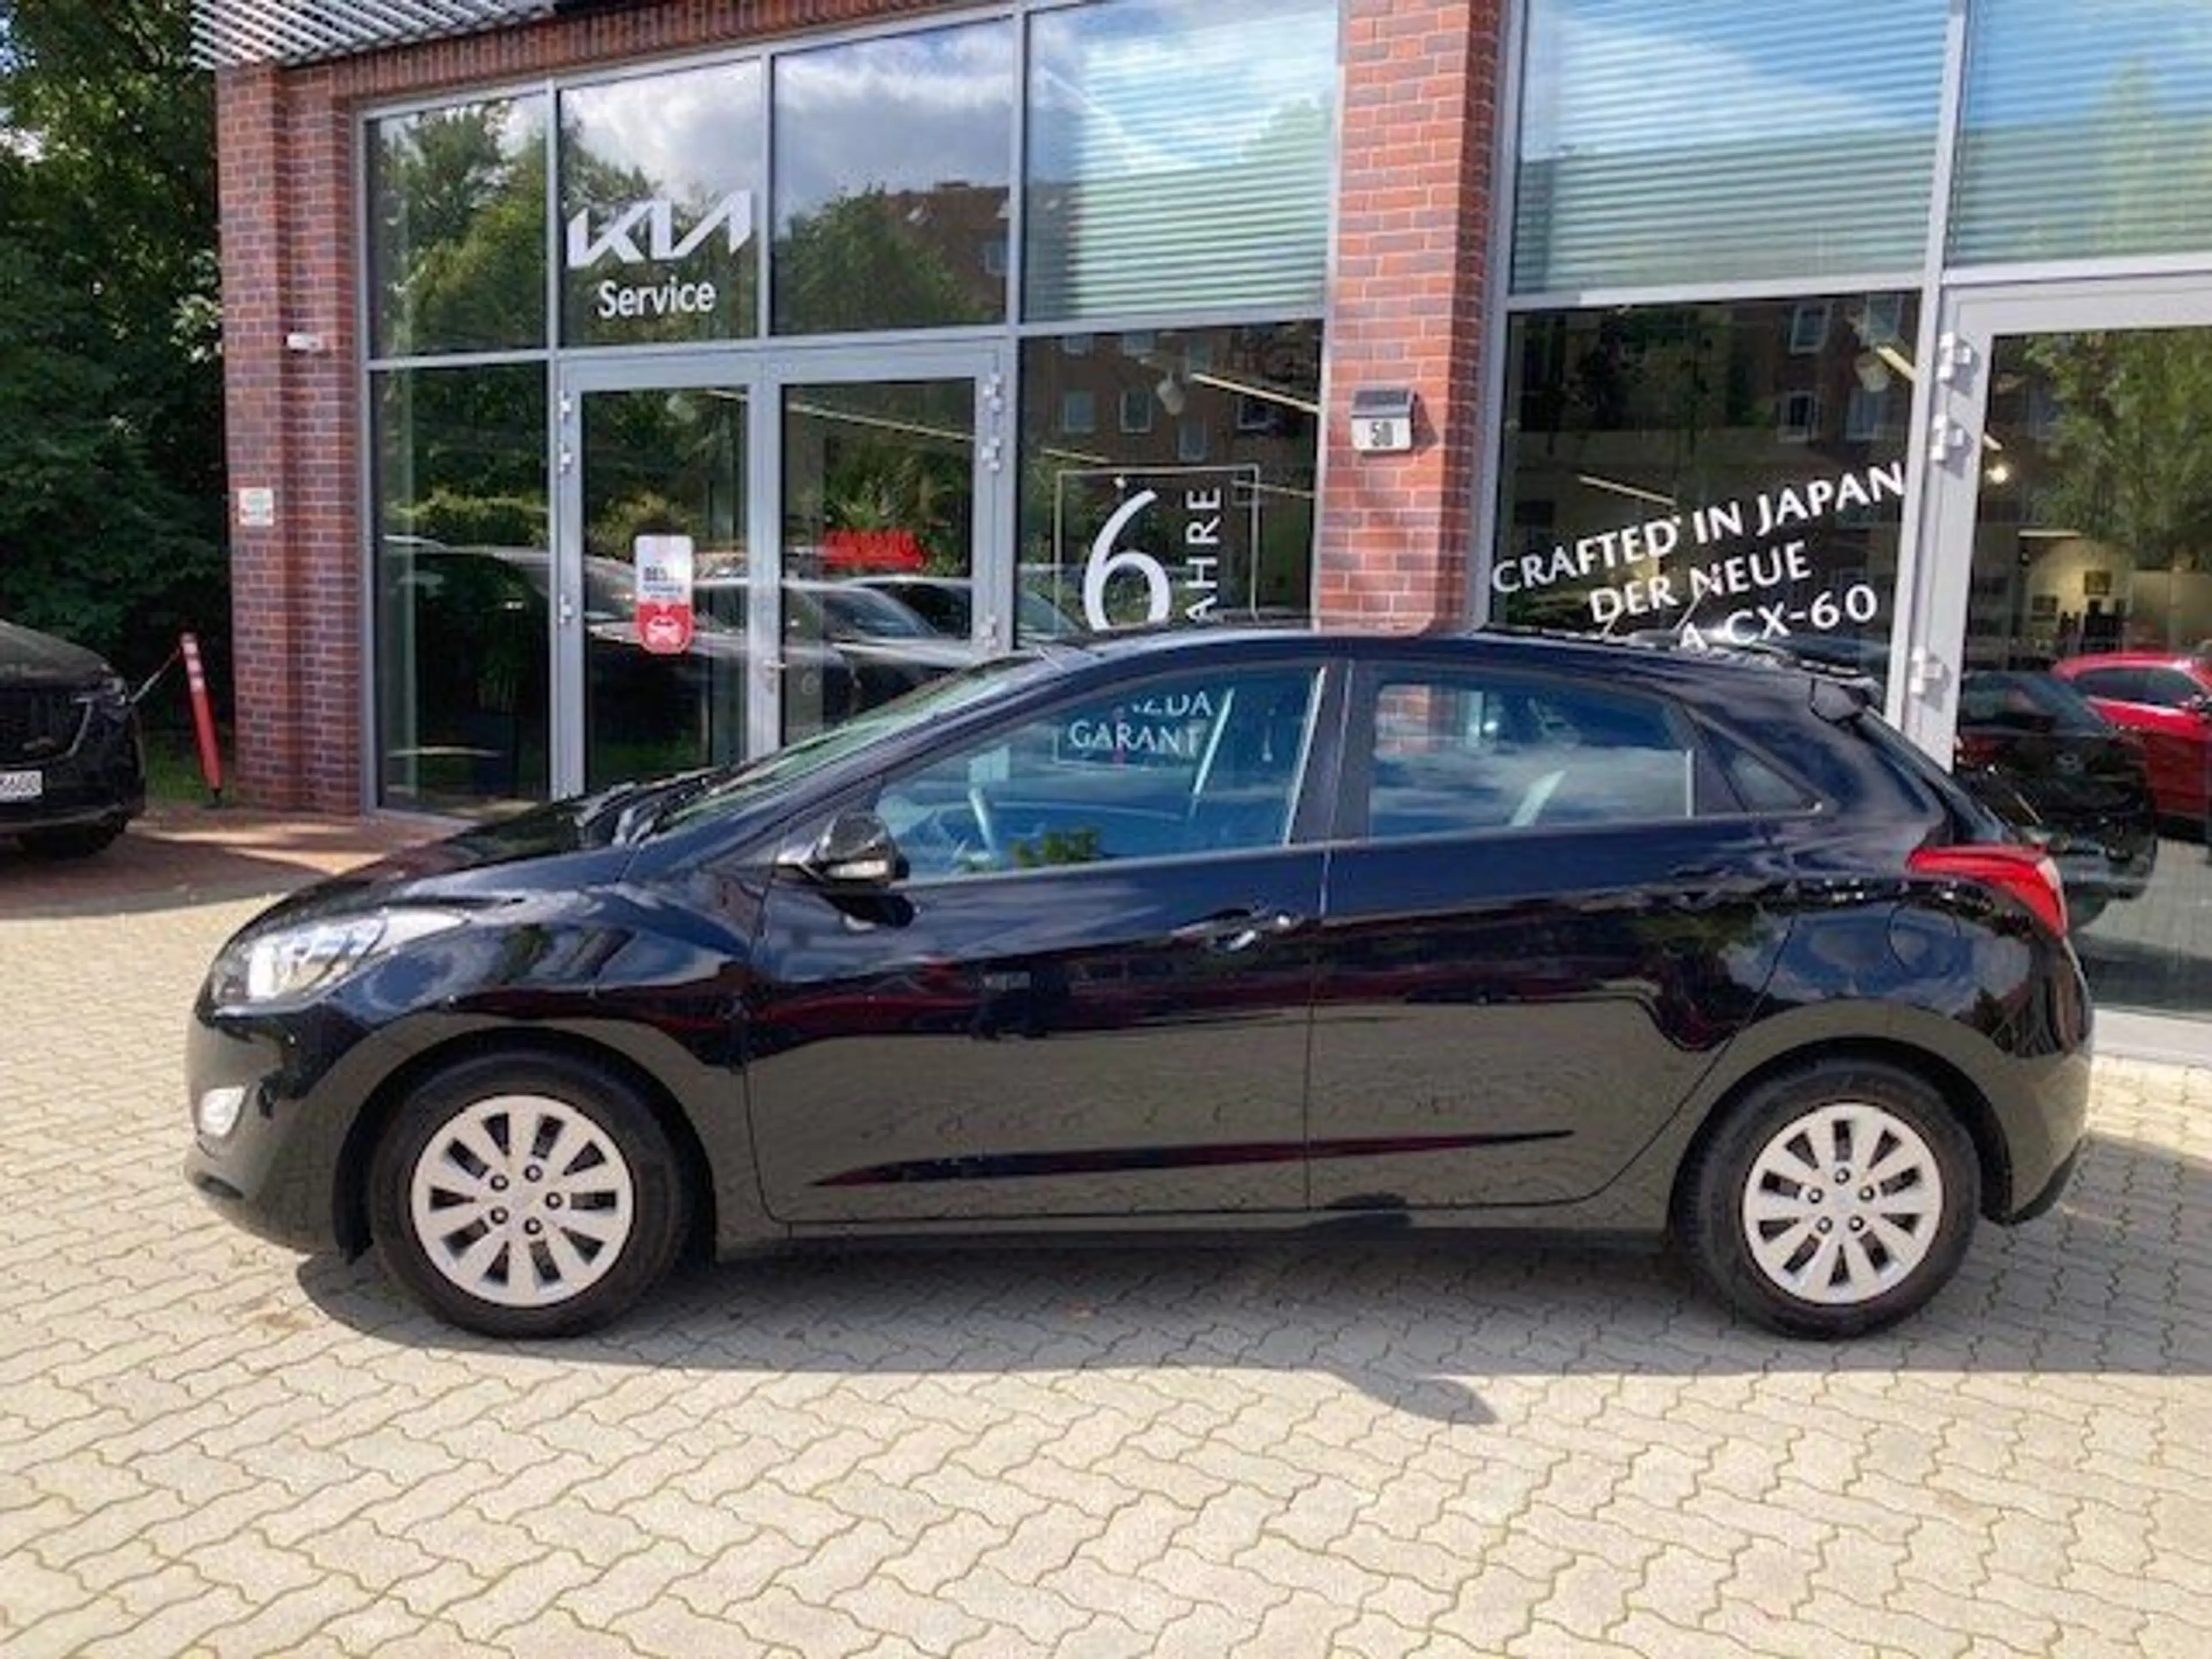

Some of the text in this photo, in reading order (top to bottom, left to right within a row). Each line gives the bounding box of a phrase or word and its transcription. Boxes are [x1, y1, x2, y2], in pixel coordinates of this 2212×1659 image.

[567, 189, 751, 268] KIA
[597, 275, 716, 318] Service
[1492, 461, 1904, 592] CRAFTED IN JAPAN
[1589, 540, 1812, 623] DER NEUE
[1726, 583, 1877, 645] CX-60
